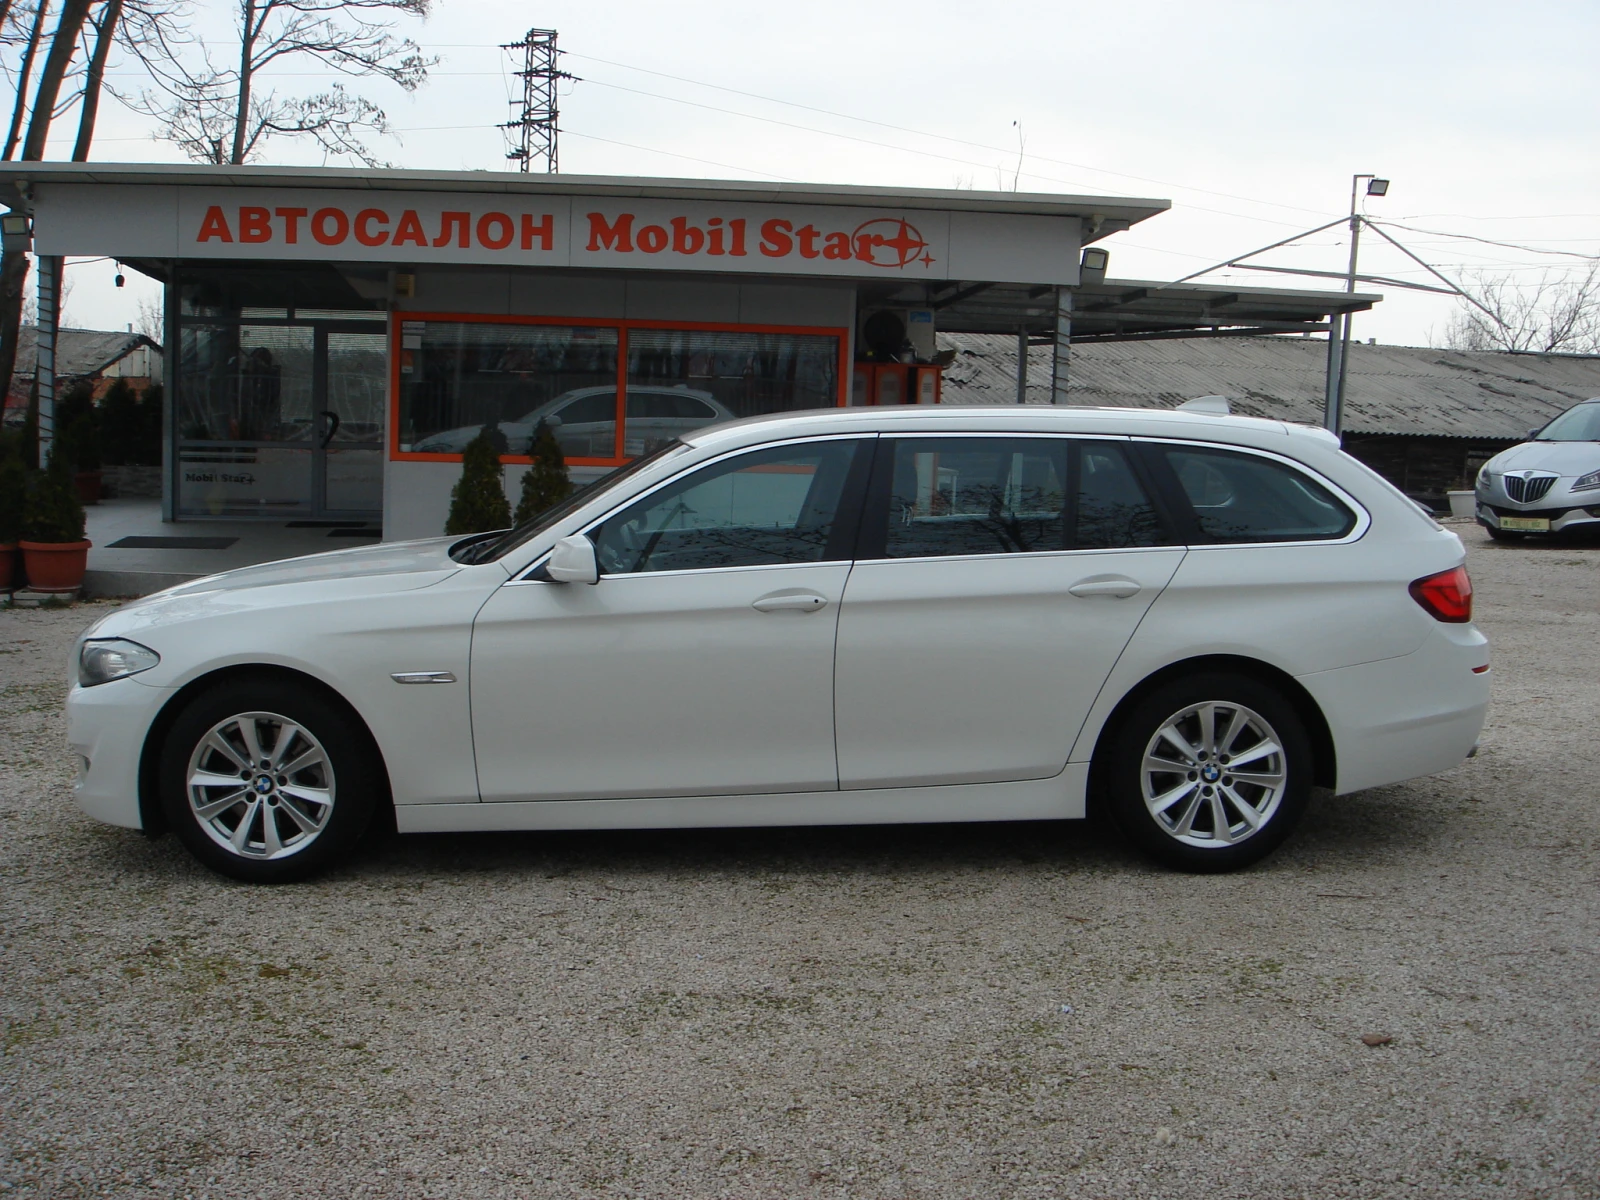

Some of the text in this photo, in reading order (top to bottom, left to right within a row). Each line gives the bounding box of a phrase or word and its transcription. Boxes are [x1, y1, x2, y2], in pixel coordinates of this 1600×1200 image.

[196, 204, 884, 262] АВТОСАЛОН Mobil Star
[185, 473, 247, 484] Mobil Star
